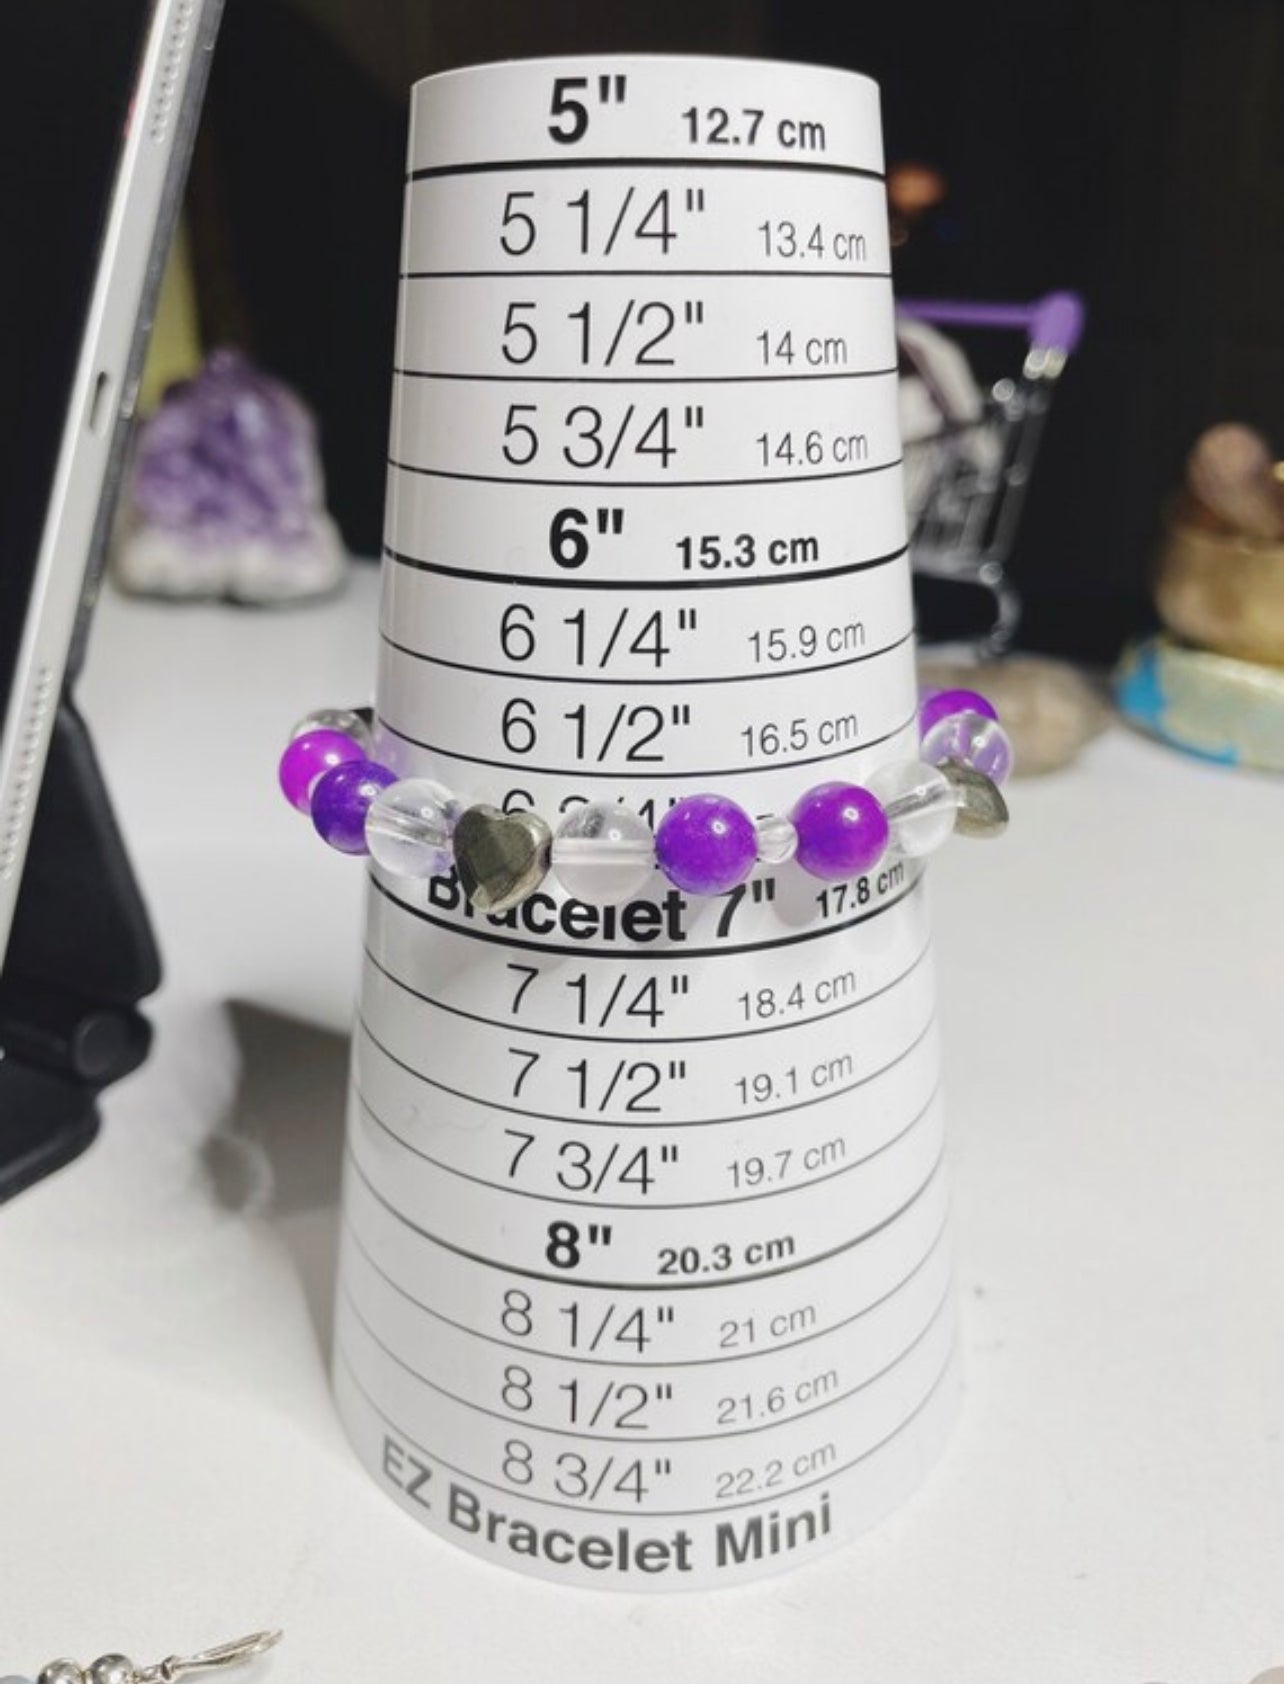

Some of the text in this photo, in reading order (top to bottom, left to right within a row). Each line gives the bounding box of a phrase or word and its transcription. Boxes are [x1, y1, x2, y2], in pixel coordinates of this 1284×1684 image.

[548, 75, 826, 150] 5" 12.7 cm
[500, 186, 865, 260] 5 1/4" 13.4 cm
[501, 299, 847, 366] 5 1/2" 14 cm
[502, 404, 866, 468] 5 3/4" 14.6 cm
[549, 508, 819, 570] 6" 15.3 cm
[501, 603, 864, 668] 6 1/4" 15.9 cm
[501, 698, 857, 762] 6 1/2" 16.5 cm
[714, 877, 776, 938] 7"
[816, 877, 870, 919] 17.8
[877, 861, 906, 897] cm
[506, 963, 855, 1028] 7 1/4" 18.4 cm
[508, 1048, 854, 1112] 7 1/2" 19.1 cm
[504, 1129, 846, 1195] 7 3/4" 19.7 cm
[546, 1221, 796, 1276] 8" 20.3 cm
[501, 1289, 817, 1353] 8 1/4" 21 cm
[501, 1365, 839, 1429] 8 1/2" 21.6 cm
[502, 1439, 837, 1504] 8 3/4" 22.2 cm
[383, 1436, 830, 1573] EZ Bracelet Mini
